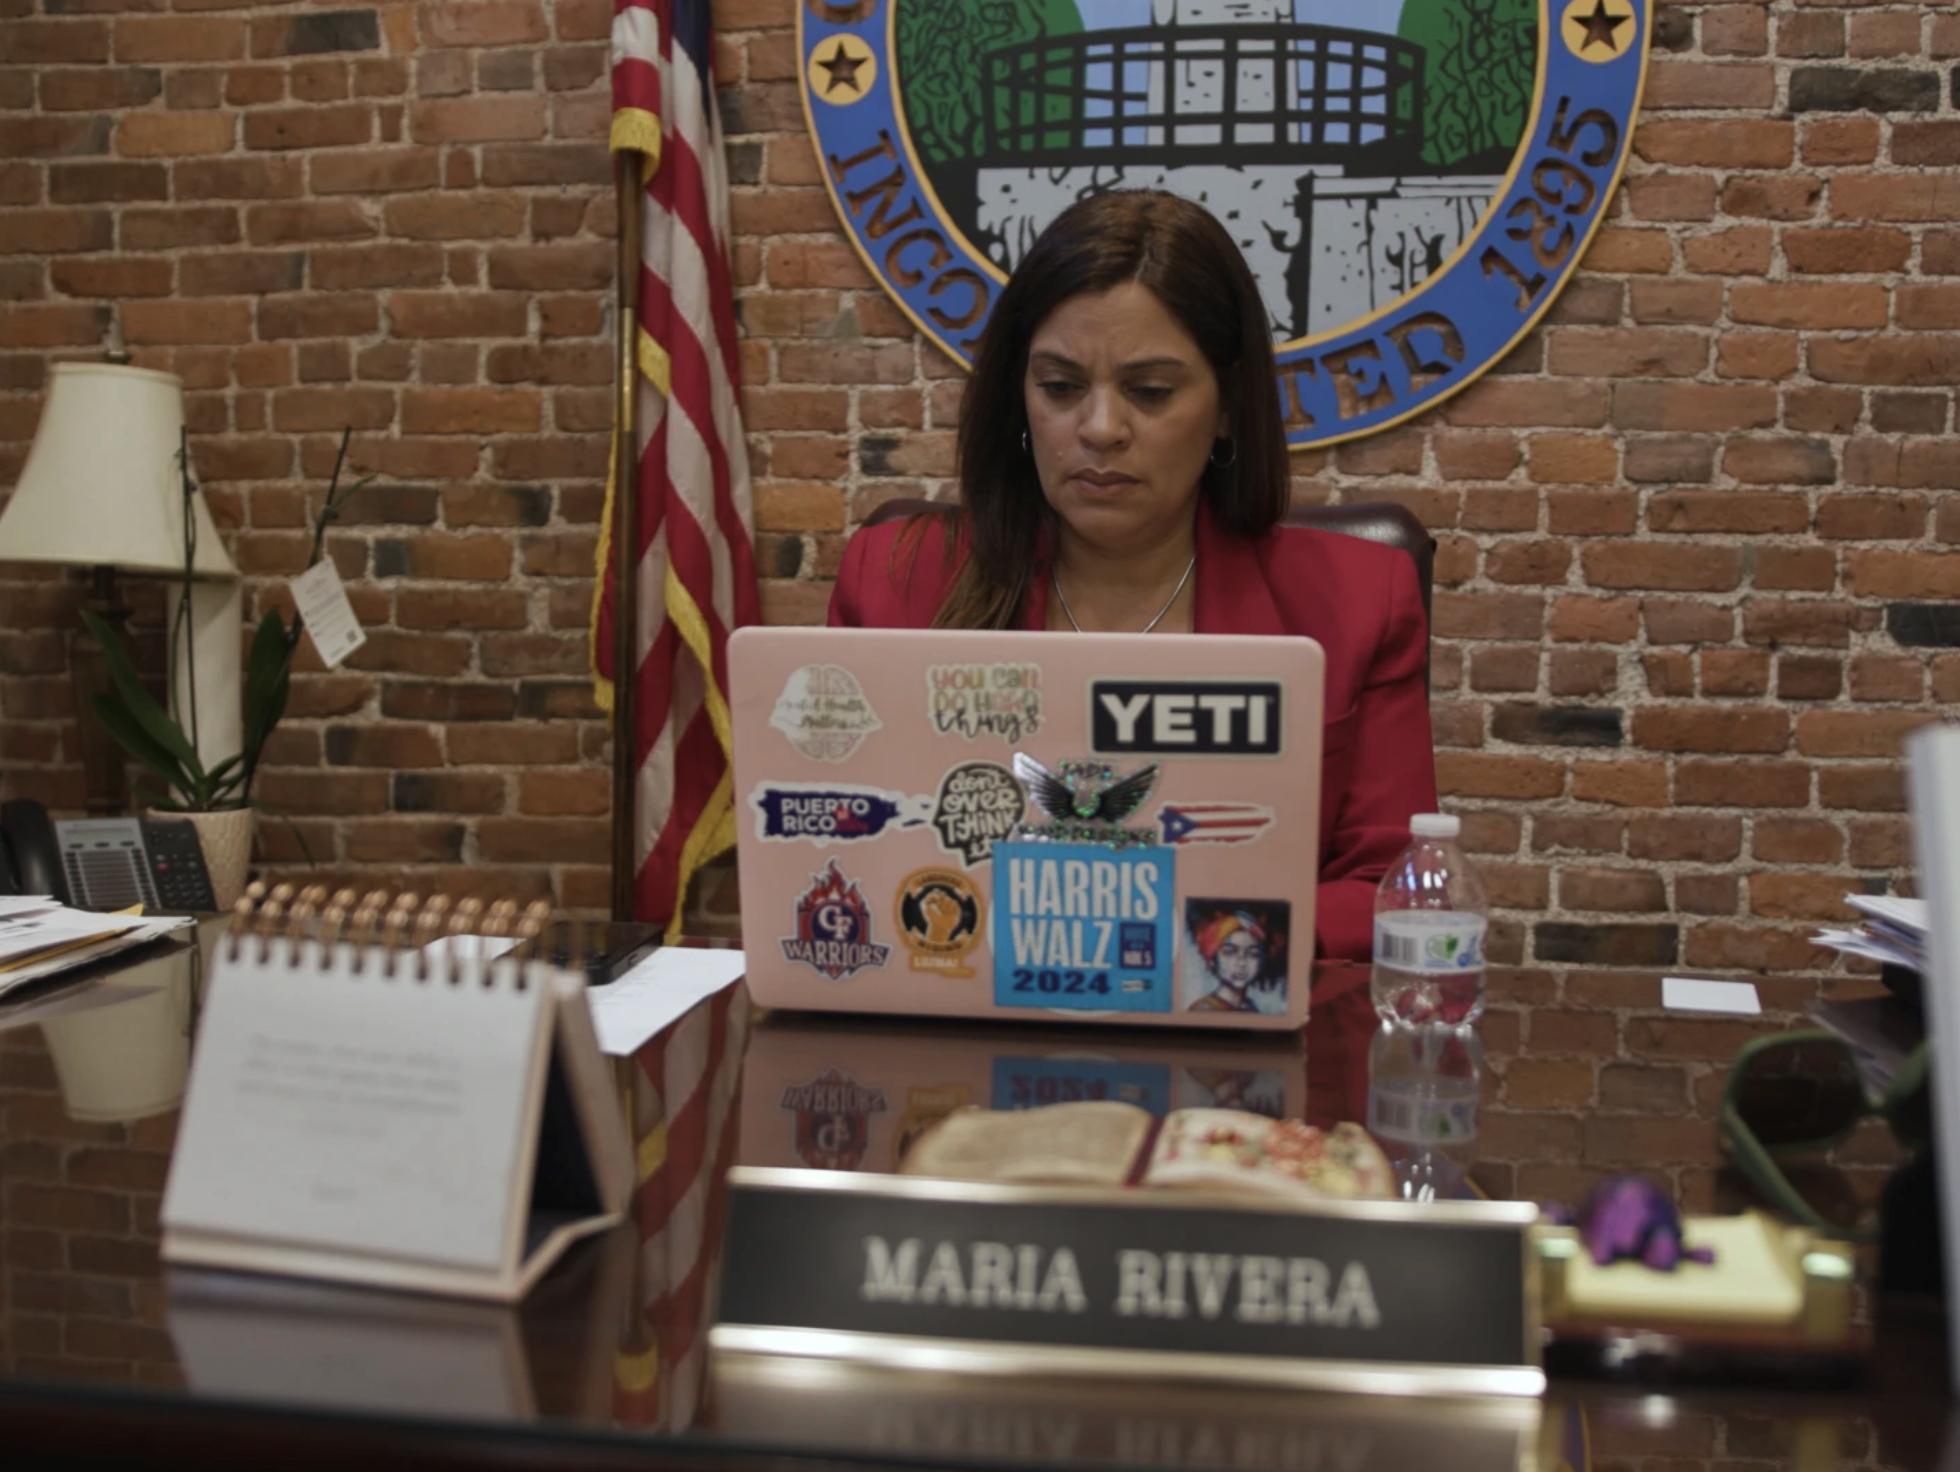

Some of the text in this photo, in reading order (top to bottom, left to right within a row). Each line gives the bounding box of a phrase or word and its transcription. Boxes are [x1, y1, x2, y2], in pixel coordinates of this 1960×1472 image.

[1479, 96, 1620, 312] 1895
[1100, 694, 1267, 744] YETI
[781, 798, 870, 815] PUERTO
[782, 815, 836, 831] RICO
[1009, 858, 1159, 920] HARRIS
[784, 940, 886, 967] WARRIORS
[1010, 918, 1114, 969] WALZ
[1011, 969, 1111, 995] 2024
[860, 1236, 1382, 1329] MARIA RIVERA
